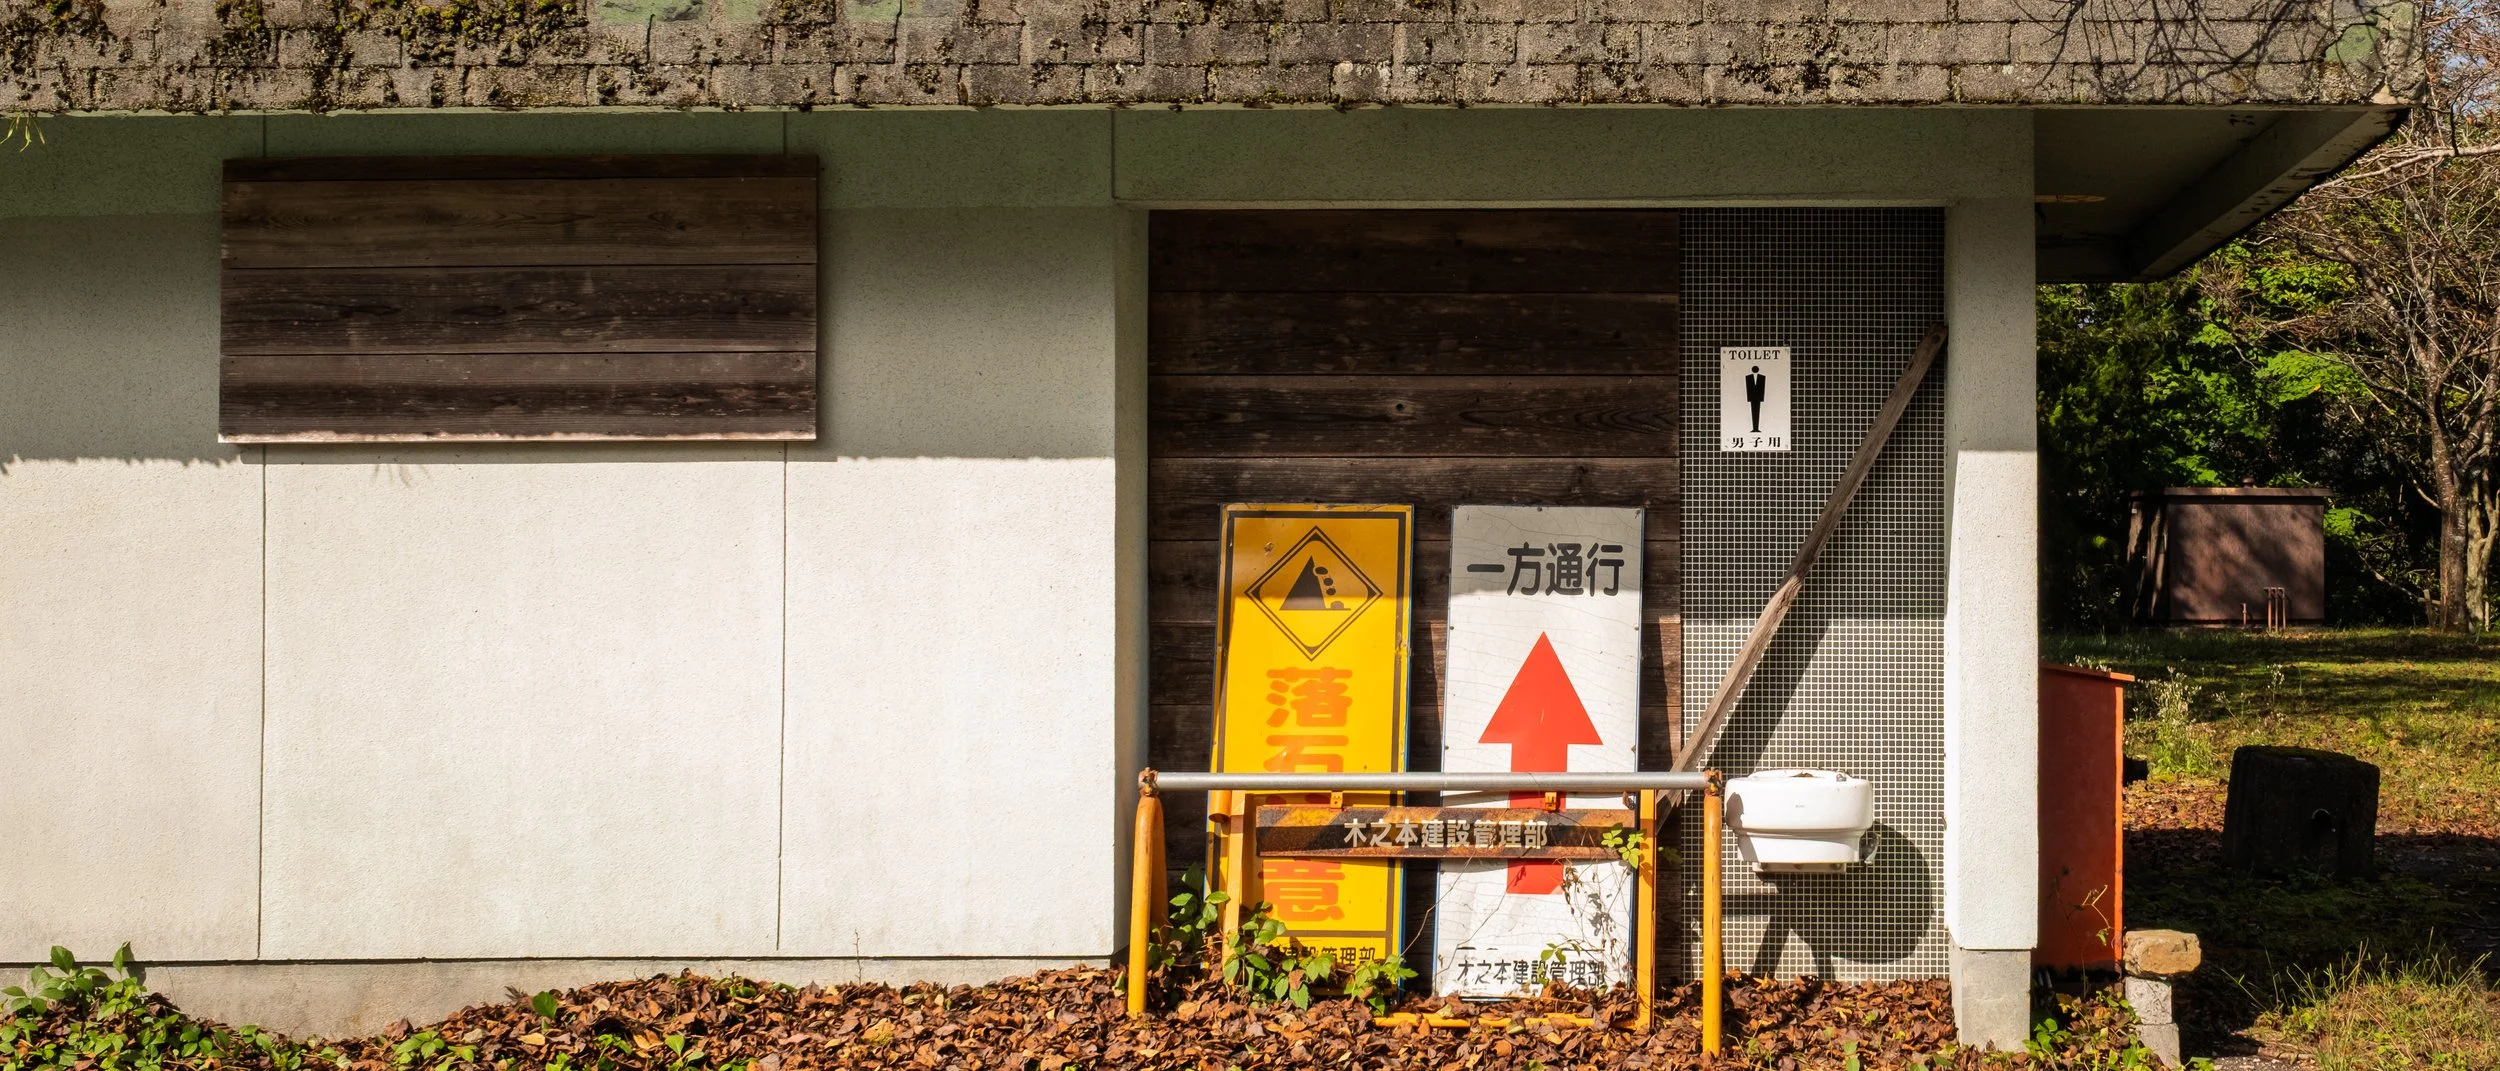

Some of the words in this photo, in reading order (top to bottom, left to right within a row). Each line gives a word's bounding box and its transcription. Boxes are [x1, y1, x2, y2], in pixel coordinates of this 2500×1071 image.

[1728, 349, 1781, 360] TOILET
[1731, 436, 1781, 449] 男子用
[1466, 541, 1625, 597] 一方通行
[1258, 666, 1354, 922] 落石意
[1343, 818, 1548, 849] 木之本建設管理部
[1456, 958, 1606, 986] 木之本建設管理部
